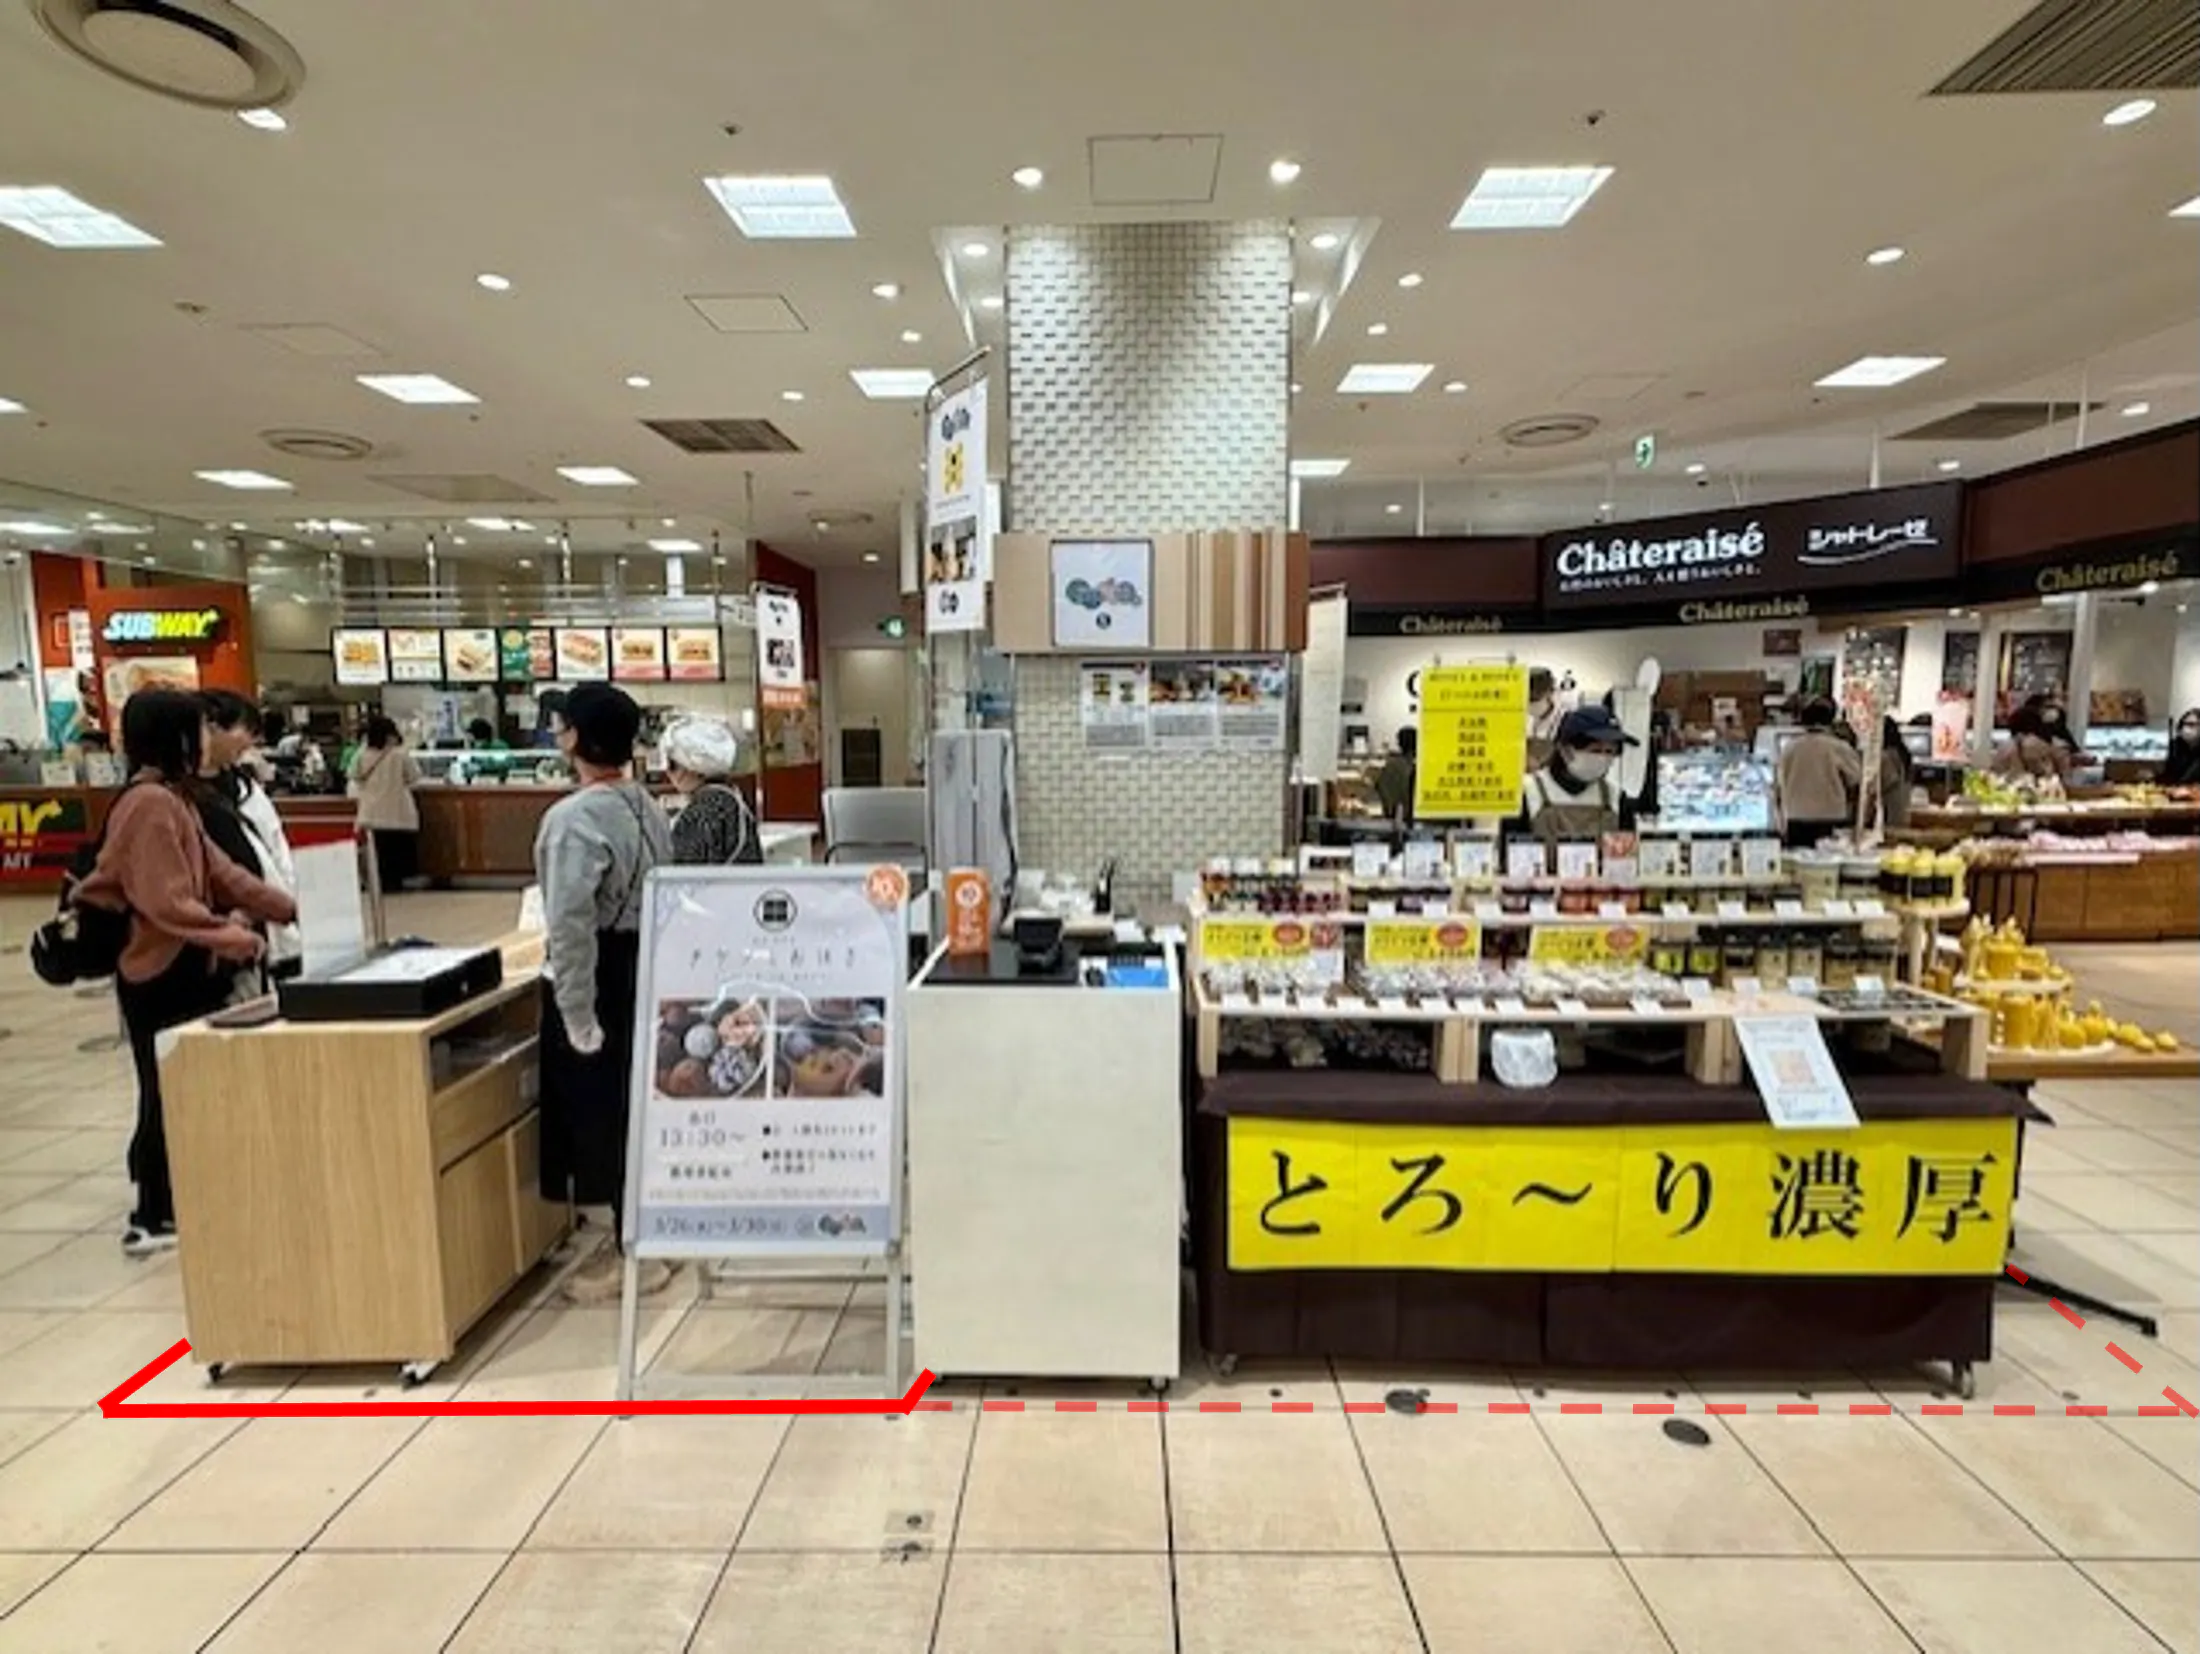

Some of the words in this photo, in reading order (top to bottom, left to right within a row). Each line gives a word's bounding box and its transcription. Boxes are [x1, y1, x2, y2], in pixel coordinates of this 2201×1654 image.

[1557, 522, 1764, 576] Châteraisé
[1808, 518, 1927, 551] シャトレーゼ
[102, 609, 218, 641] SUBWAY
[1678, 595, 1809, 624] Châteraisé
